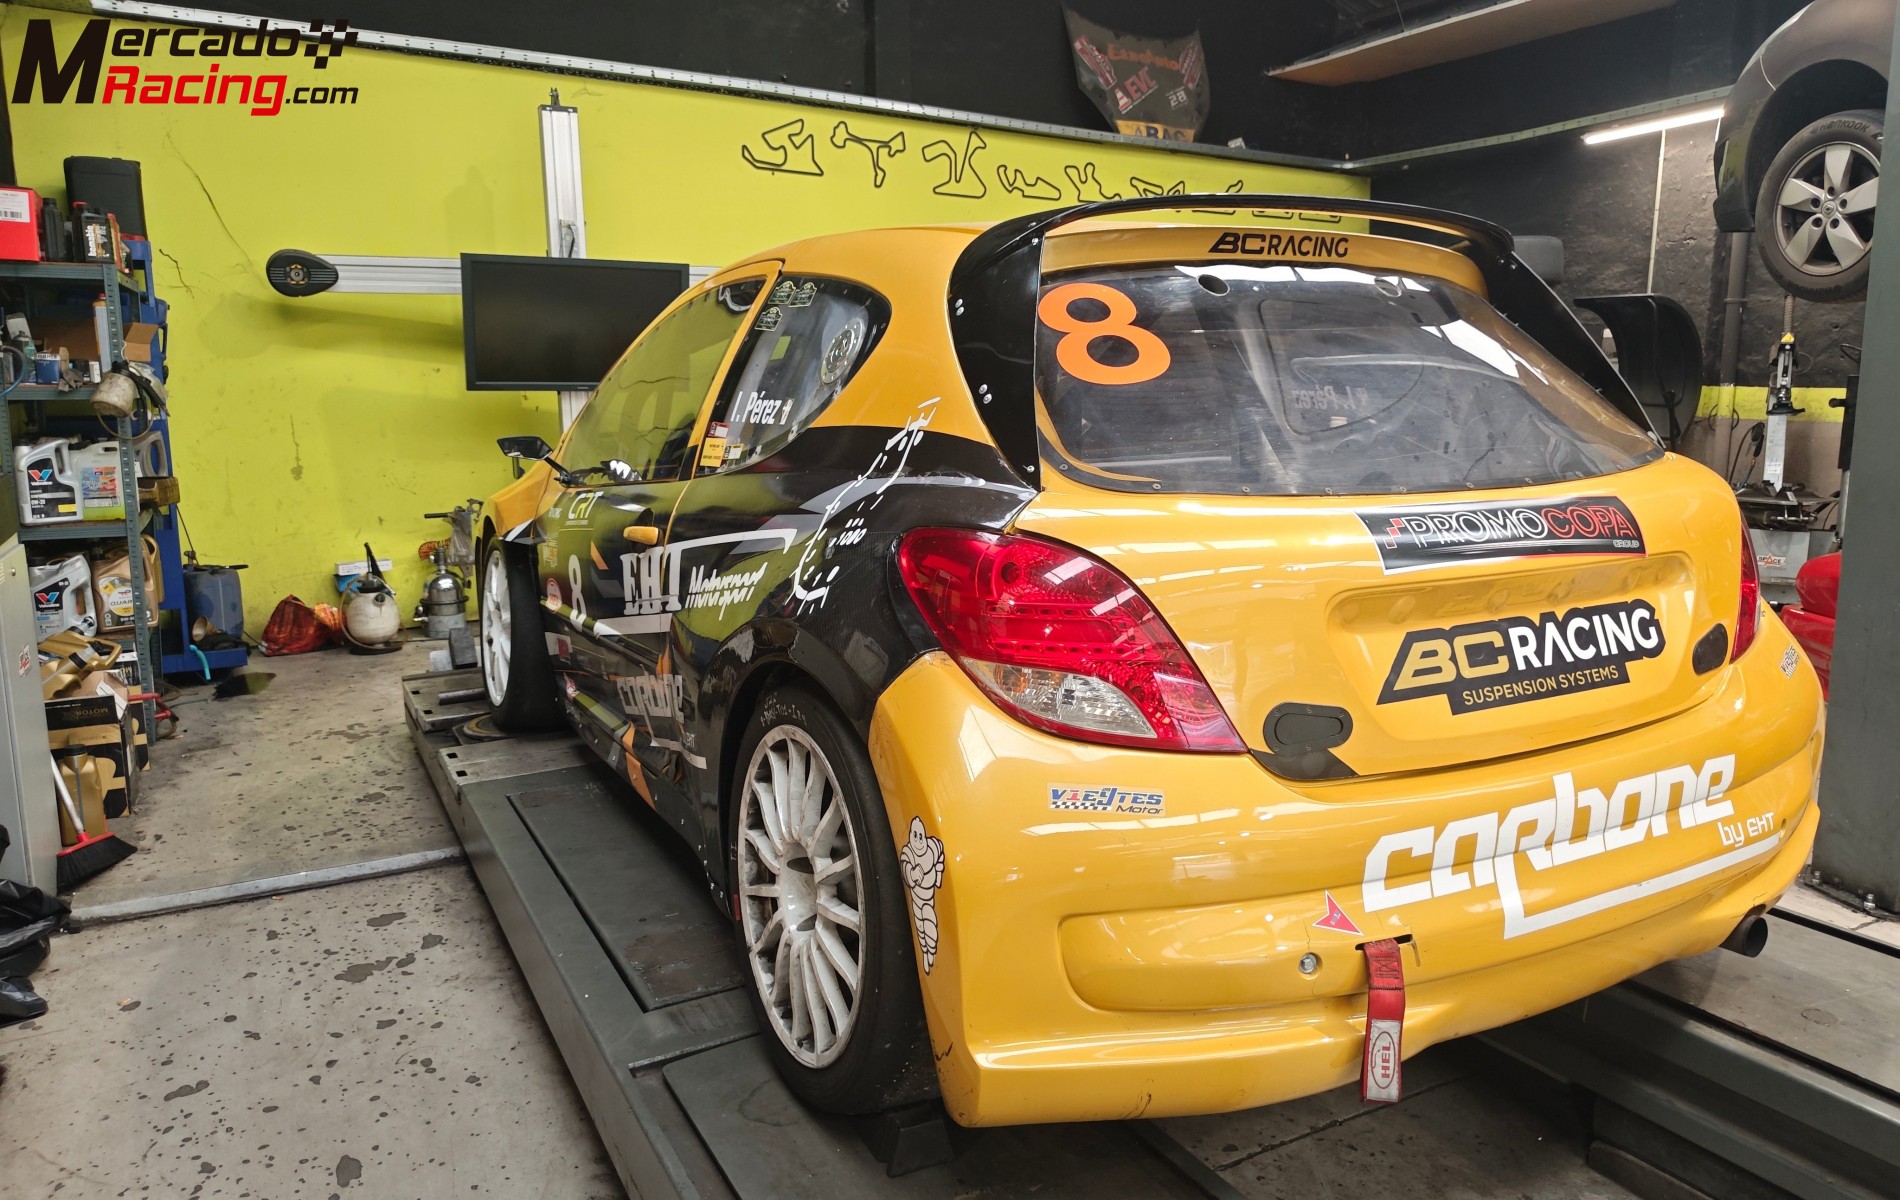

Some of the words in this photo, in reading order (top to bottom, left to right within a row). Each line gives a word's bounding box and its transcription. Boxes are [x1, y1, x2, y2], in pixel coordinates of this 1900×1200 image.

[1037, 282, 1171, 385] 8
[741, 391, 782, 424] Pérez
[568, 554, 587, 632] 8
[1463, 676, 1558, 706] SUSPENSION
[1559, 665, 1619, 689] SYSTEMS
[1115, 804, 1163, 815] Motor
[1719, 820, 1745, 848] by
[1746, 812, 1775, 839] EHT
[1380, 1041, 1392, 1079] HEL
